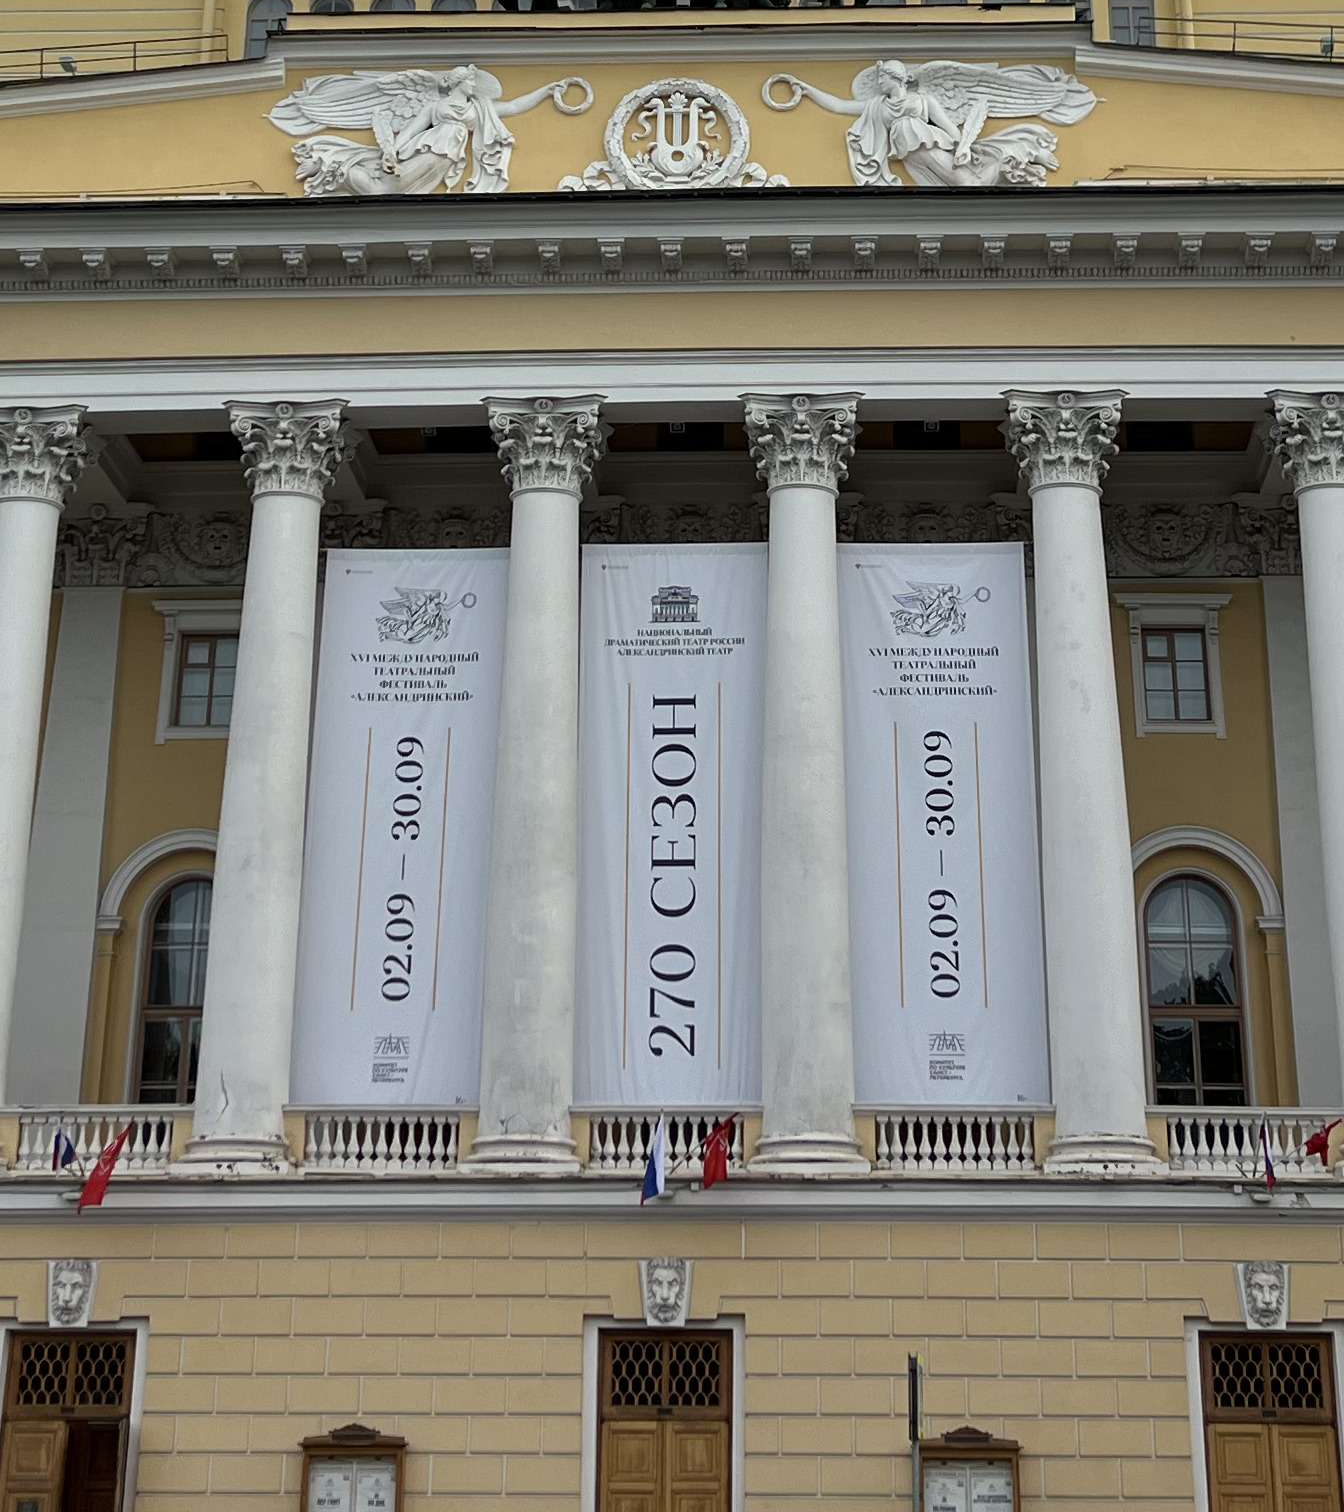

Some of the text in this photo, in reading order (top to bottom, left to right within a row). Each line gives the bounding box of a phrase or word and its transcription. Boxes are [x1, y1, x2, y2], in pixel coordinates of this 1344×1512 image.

[637, 627, 713, 637] НАЦИОНАЛЬНЫЙ
[605, 637, 745, 648] ДРАМАТИЧЕСКИЙ ТЕАТР РОССИИ
[617, 647, 734, 657] АЛЕКСАНДРИНСКИЙ ТЕАТР
[890, 646, 1000, 657] МЕЖДУНАРОДНЫЙ
[373, 651, 479, 664] МЕЖДУНАРОДНЫЙ
[892, 658, 977, 669] ТЕАТРАЛЬНЫЙ
[373, 665, 456, 676] ТЕАТРАЛЬНЫЙ
[899, 673, 970, 683] ФЕСТИВАЛЬ
[379, 679, 448, 689] ФЕСТИВАЛЬ
[390, 736, 424, 841] 30.09
[923, 730, 956, 837] 30.09
[648, 694, 697, 1057] 270 СЕЗОН
[380, 893, 416, 1002] 02.09
[927, 889, 961, 998] 02.09
